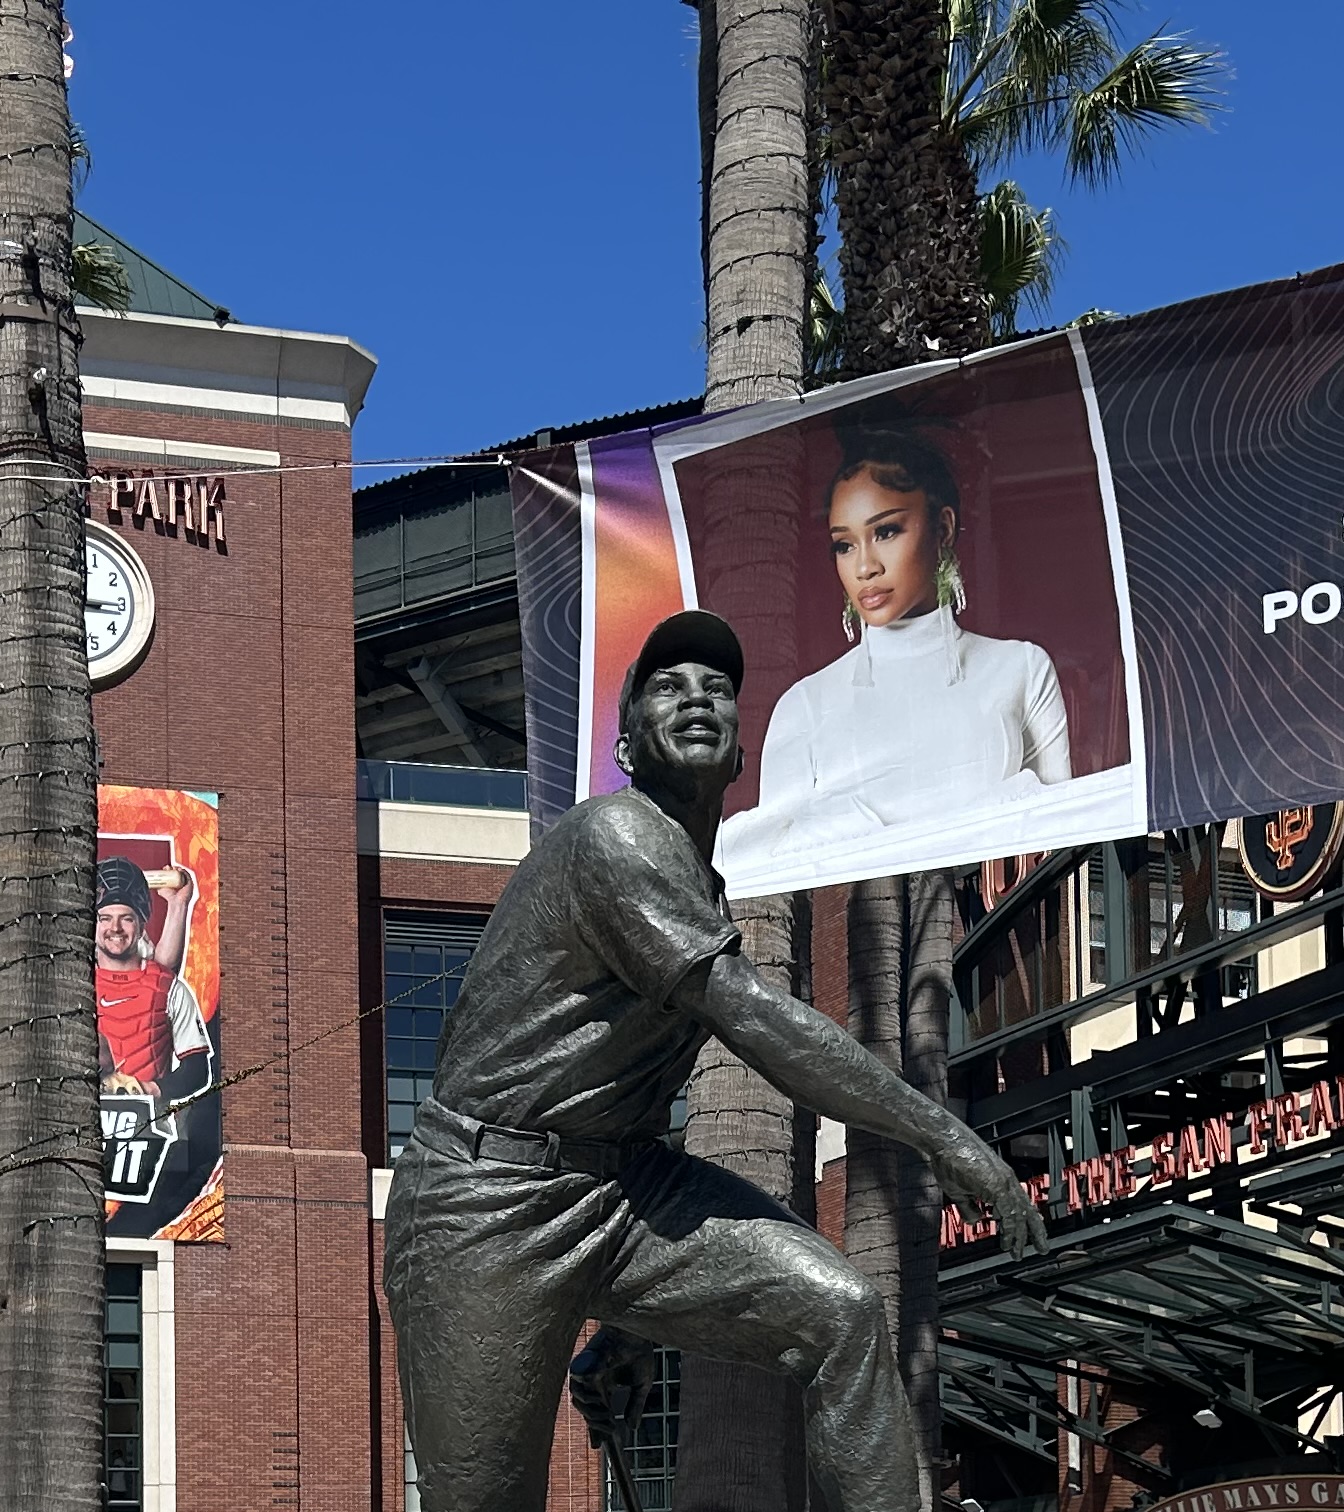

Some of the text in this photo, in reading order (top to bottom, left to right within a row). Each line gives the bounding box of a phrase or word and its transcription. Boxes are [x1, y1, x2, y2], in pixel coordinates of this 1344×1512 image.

[108, 470, 226, 541] PARK
[92, 554, 98, 568] 1
[109, 572, 117, 587] 2
[117, 597, 126, 611] 3
[107, 621, 117, 635] 4
[91, 636, 99, 650] 5
[111, 1141, 148, 1183] IT
[1062, 1145, 1136, 1213] THE
[1152, 1112, 1233, 1184] SAN
[1222, 1483, 1300, 1509] MAYS
